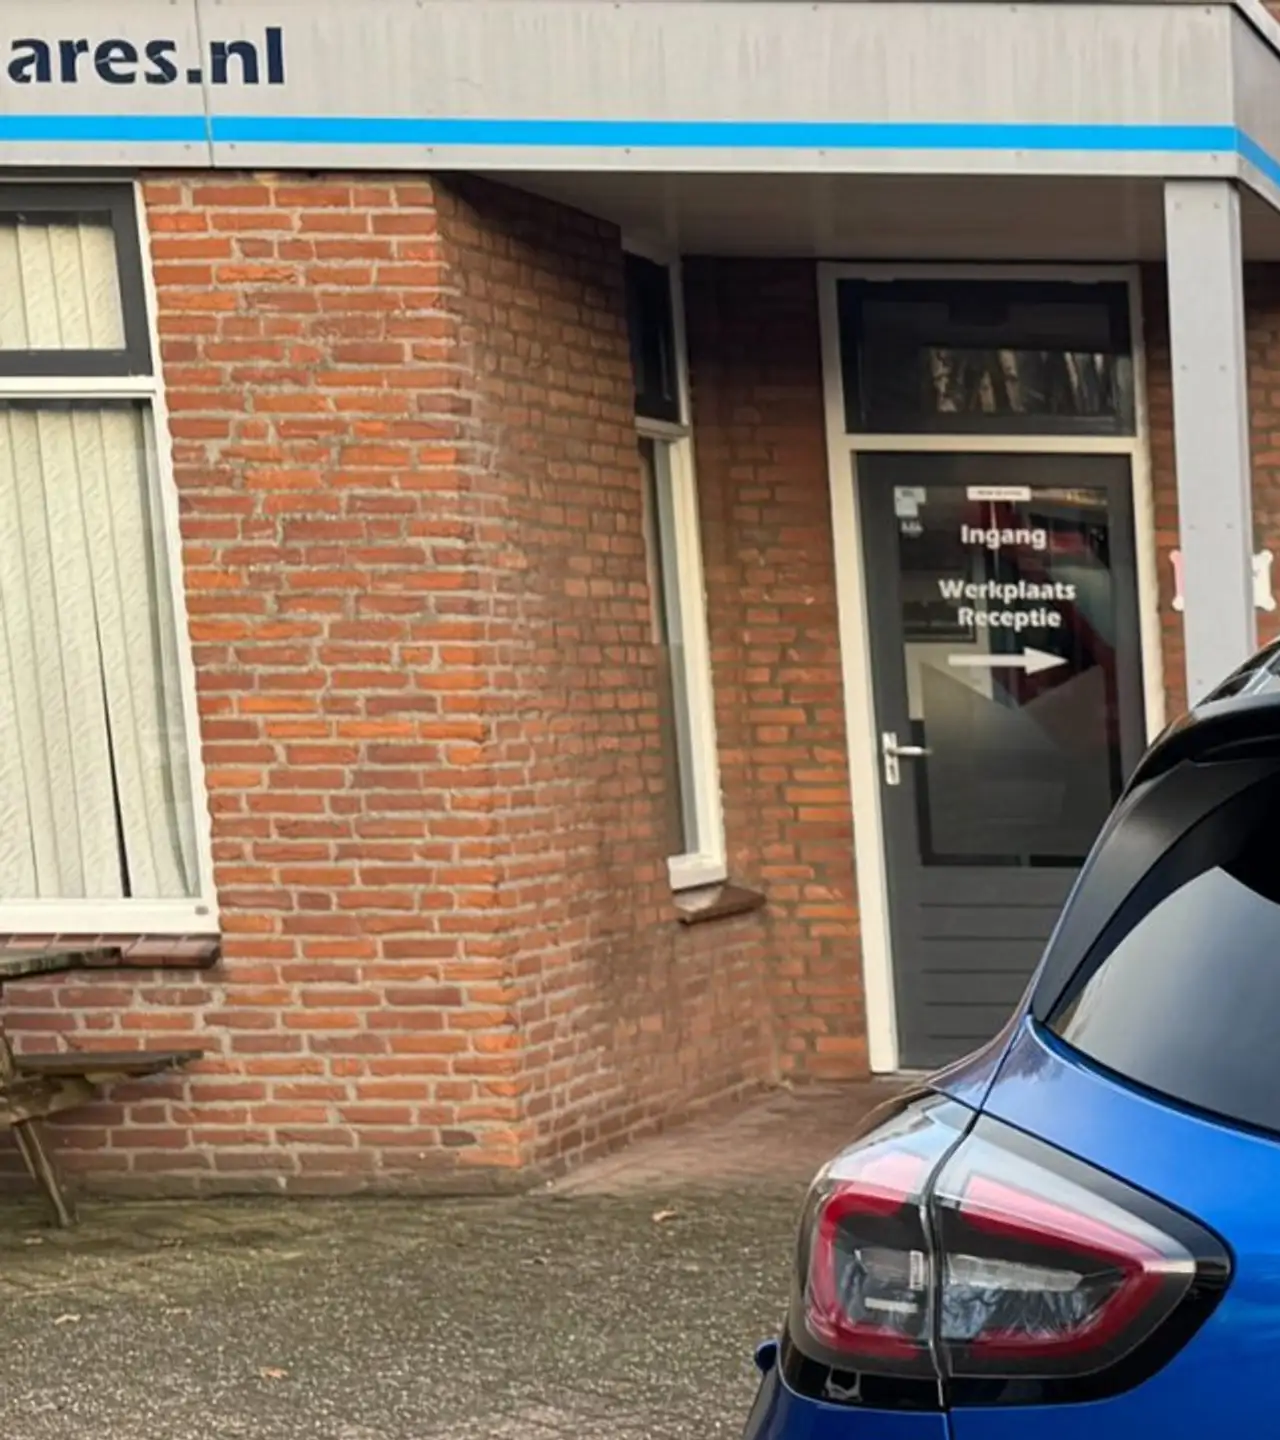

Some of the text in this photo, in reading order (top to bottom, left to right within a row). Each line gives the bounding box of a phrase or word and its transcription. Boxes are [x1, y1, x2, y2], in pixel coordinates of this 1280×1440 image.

[7, 26, 284, 85] ares.nl
[961, 524, 1047, 549] Ingang
[938, 579, 1076, 605] Werkplaats
[957, 606, 1062, 632] Receptie
